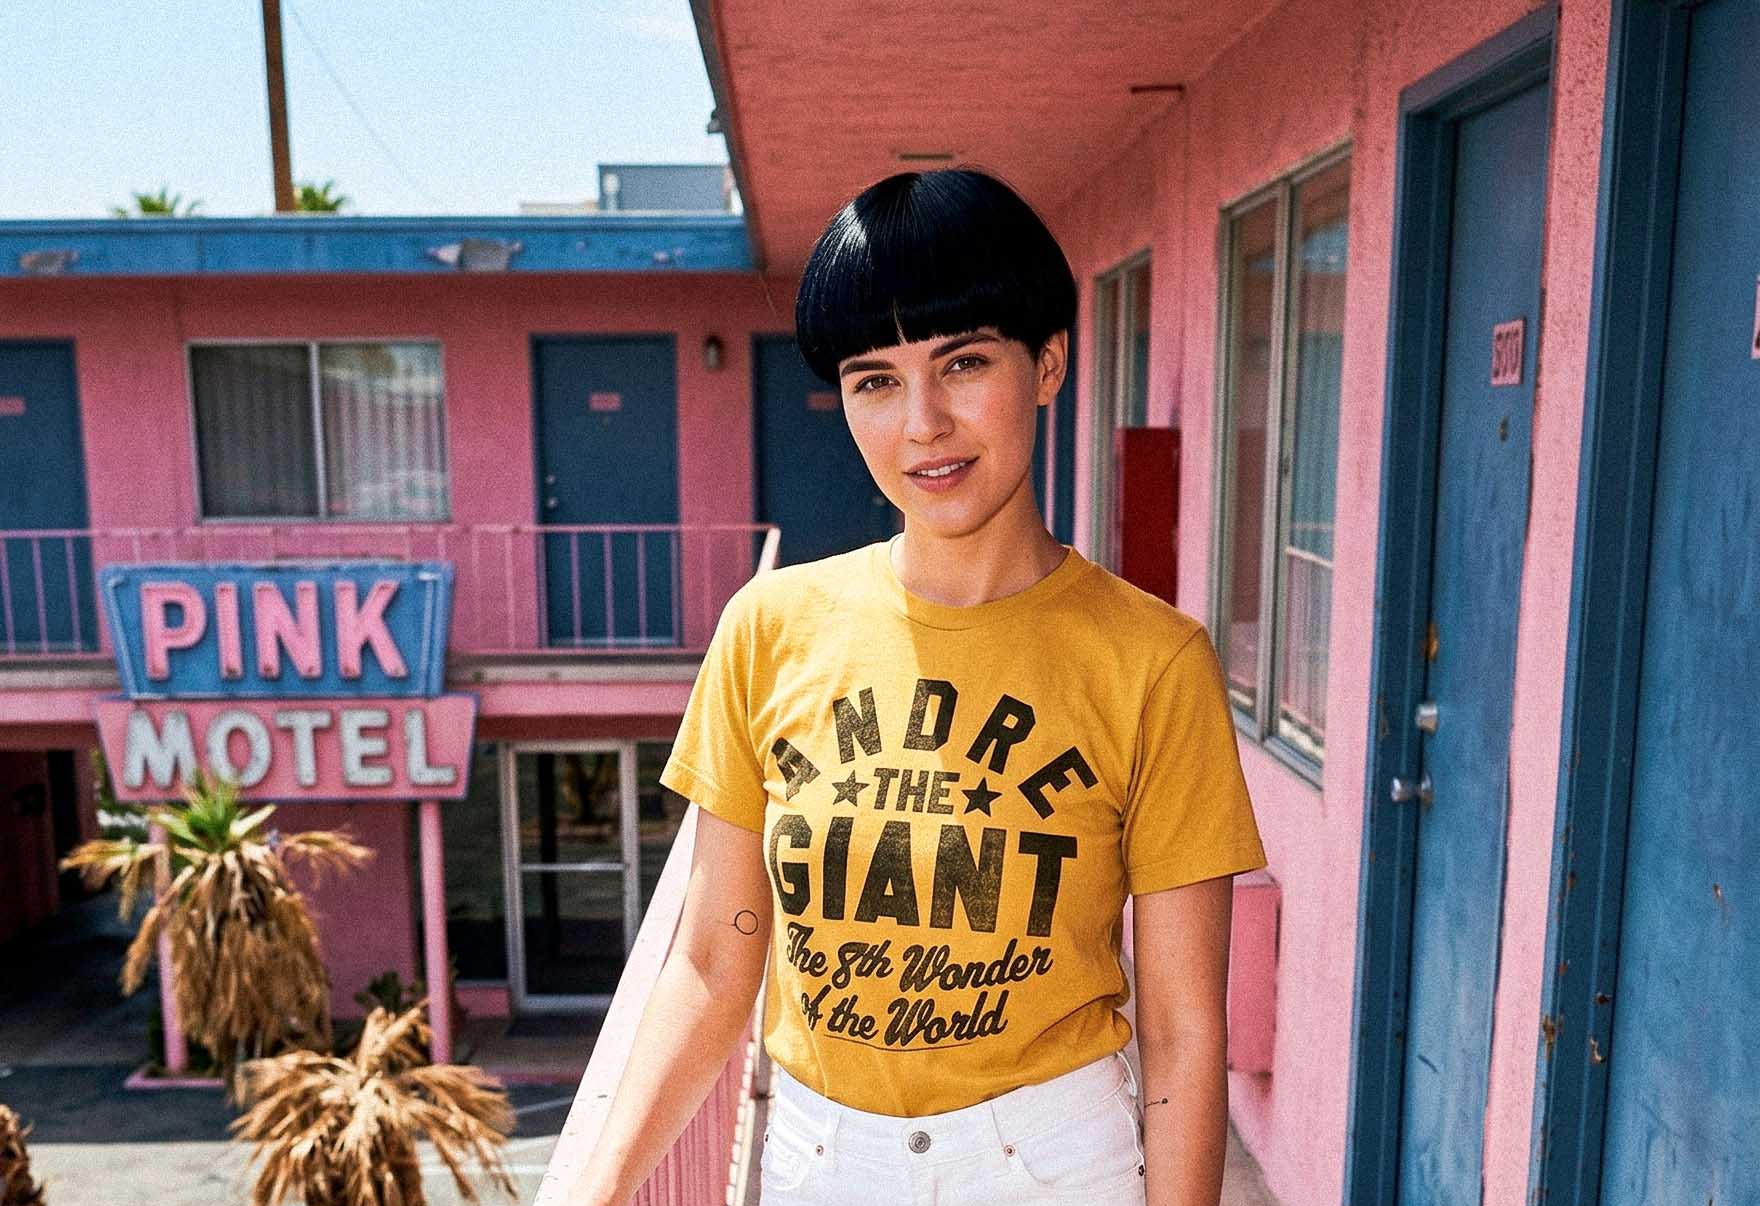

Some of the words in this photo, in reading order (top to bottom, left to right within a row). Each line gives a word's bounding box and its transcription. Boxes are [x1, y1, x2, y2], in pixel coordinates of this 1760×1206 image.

[140, 580, 408, 680] PINK
[124, 708, 456, 788] MOTEL
[771, 678, 1099, 820] ANDRE
[872, 766, 961, 815] THE
[769, 813, 1078, 938] GIANT
[785, 921, 829, 978] The
[831, 939, 894, 990] 8th
[899, 937, 1054, 993] Wonder
[800, 984, 832, 1031] of
[827, 994, 879, 1040] the
[883, 989, 1010, 1047] World
